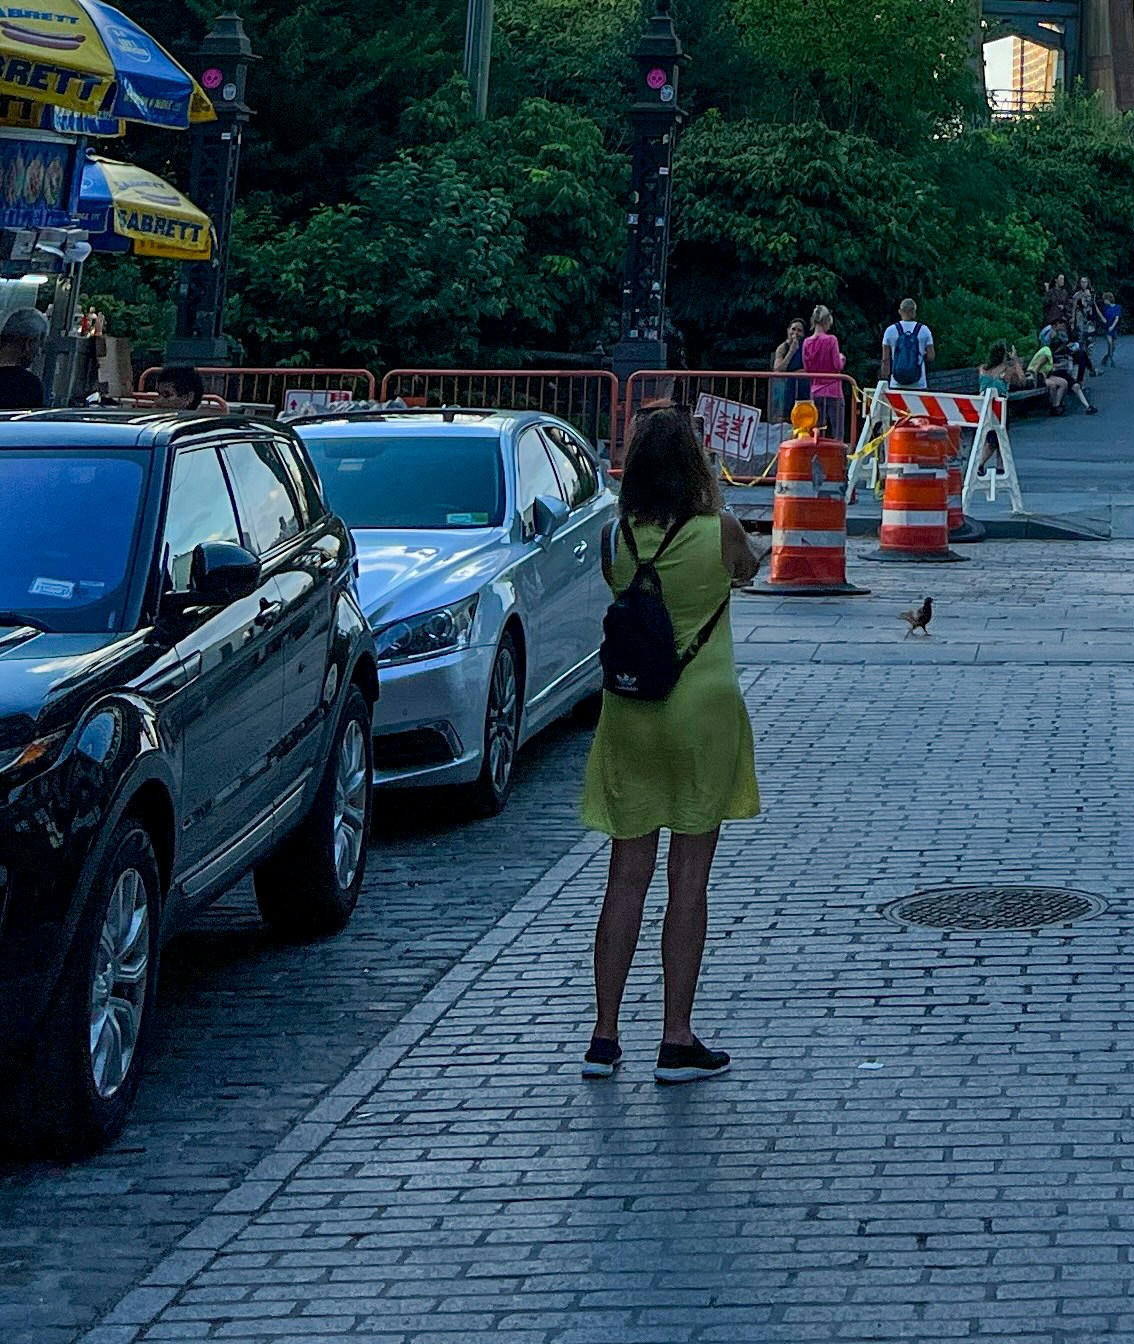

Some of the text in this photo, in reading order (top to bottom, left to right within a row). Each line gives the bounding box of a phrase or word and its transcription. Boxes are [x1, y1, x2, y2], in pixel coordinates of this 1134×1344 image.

[0, 55, 103, 100] RETT
[117, 209, 204, 243] SABRETT
[714, 410, 732, 440] ANY
[727, 413, 746, 442] TIME
